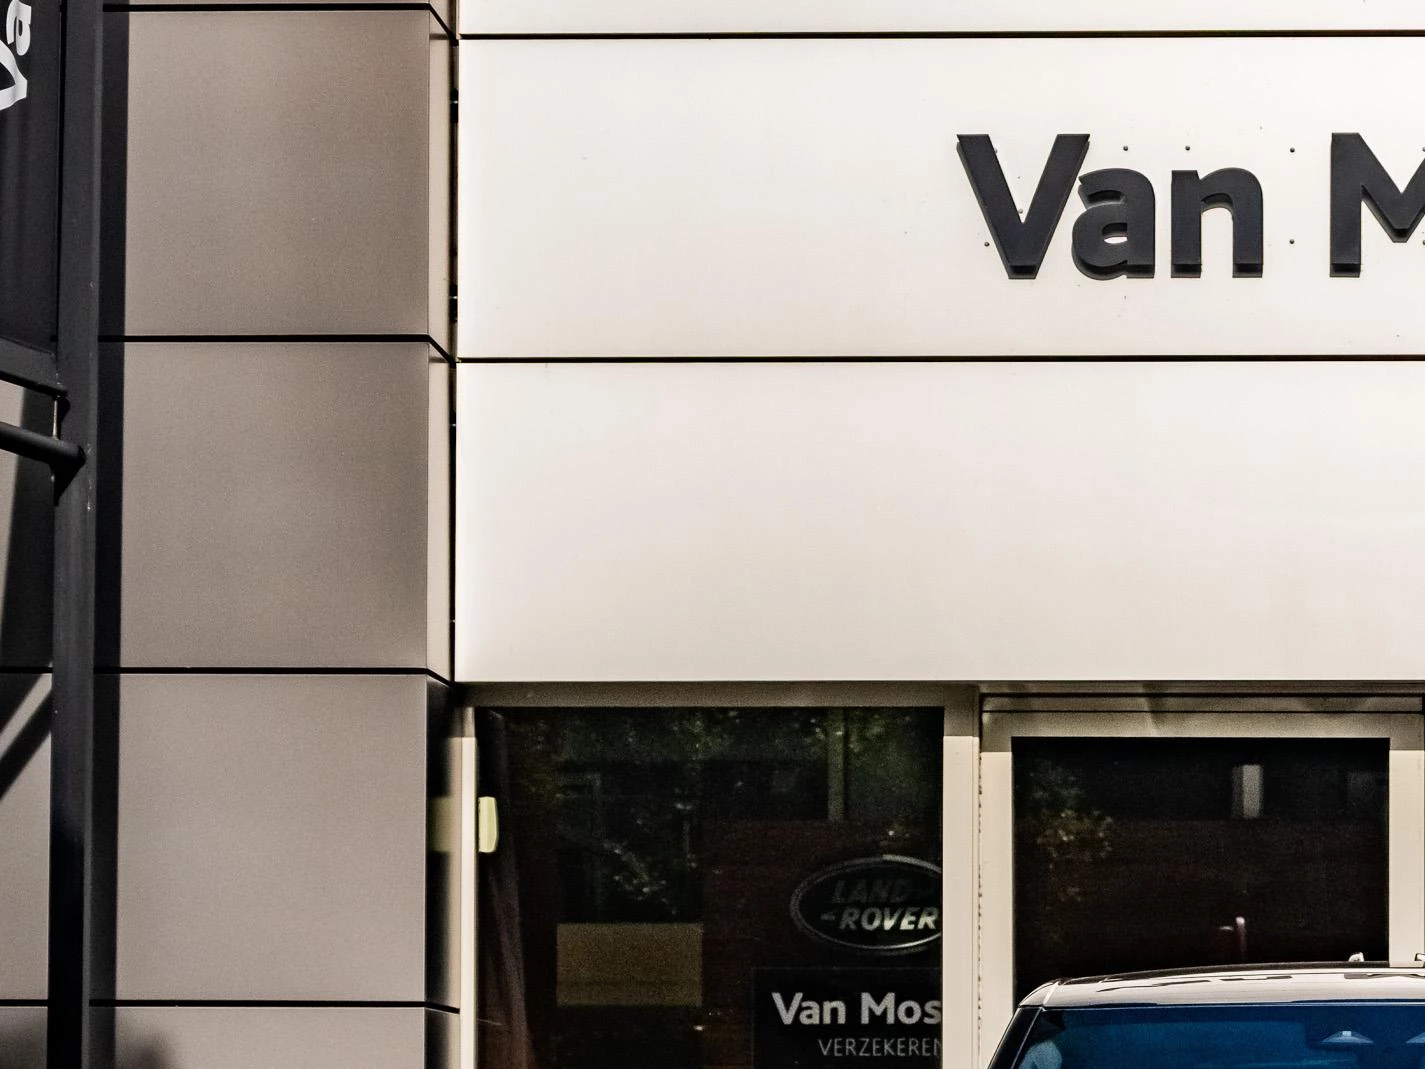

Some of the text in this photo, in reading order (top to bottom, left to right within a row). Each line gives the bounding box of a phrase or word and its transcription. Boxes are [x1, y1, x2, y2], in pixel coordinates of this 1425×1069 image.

[0, 0, 32, 110] Va
[957, 133, 1264, 280] Van
[839, 907, 940, 931] ROVER
[772, 991, 942, 1025] Van Mos
